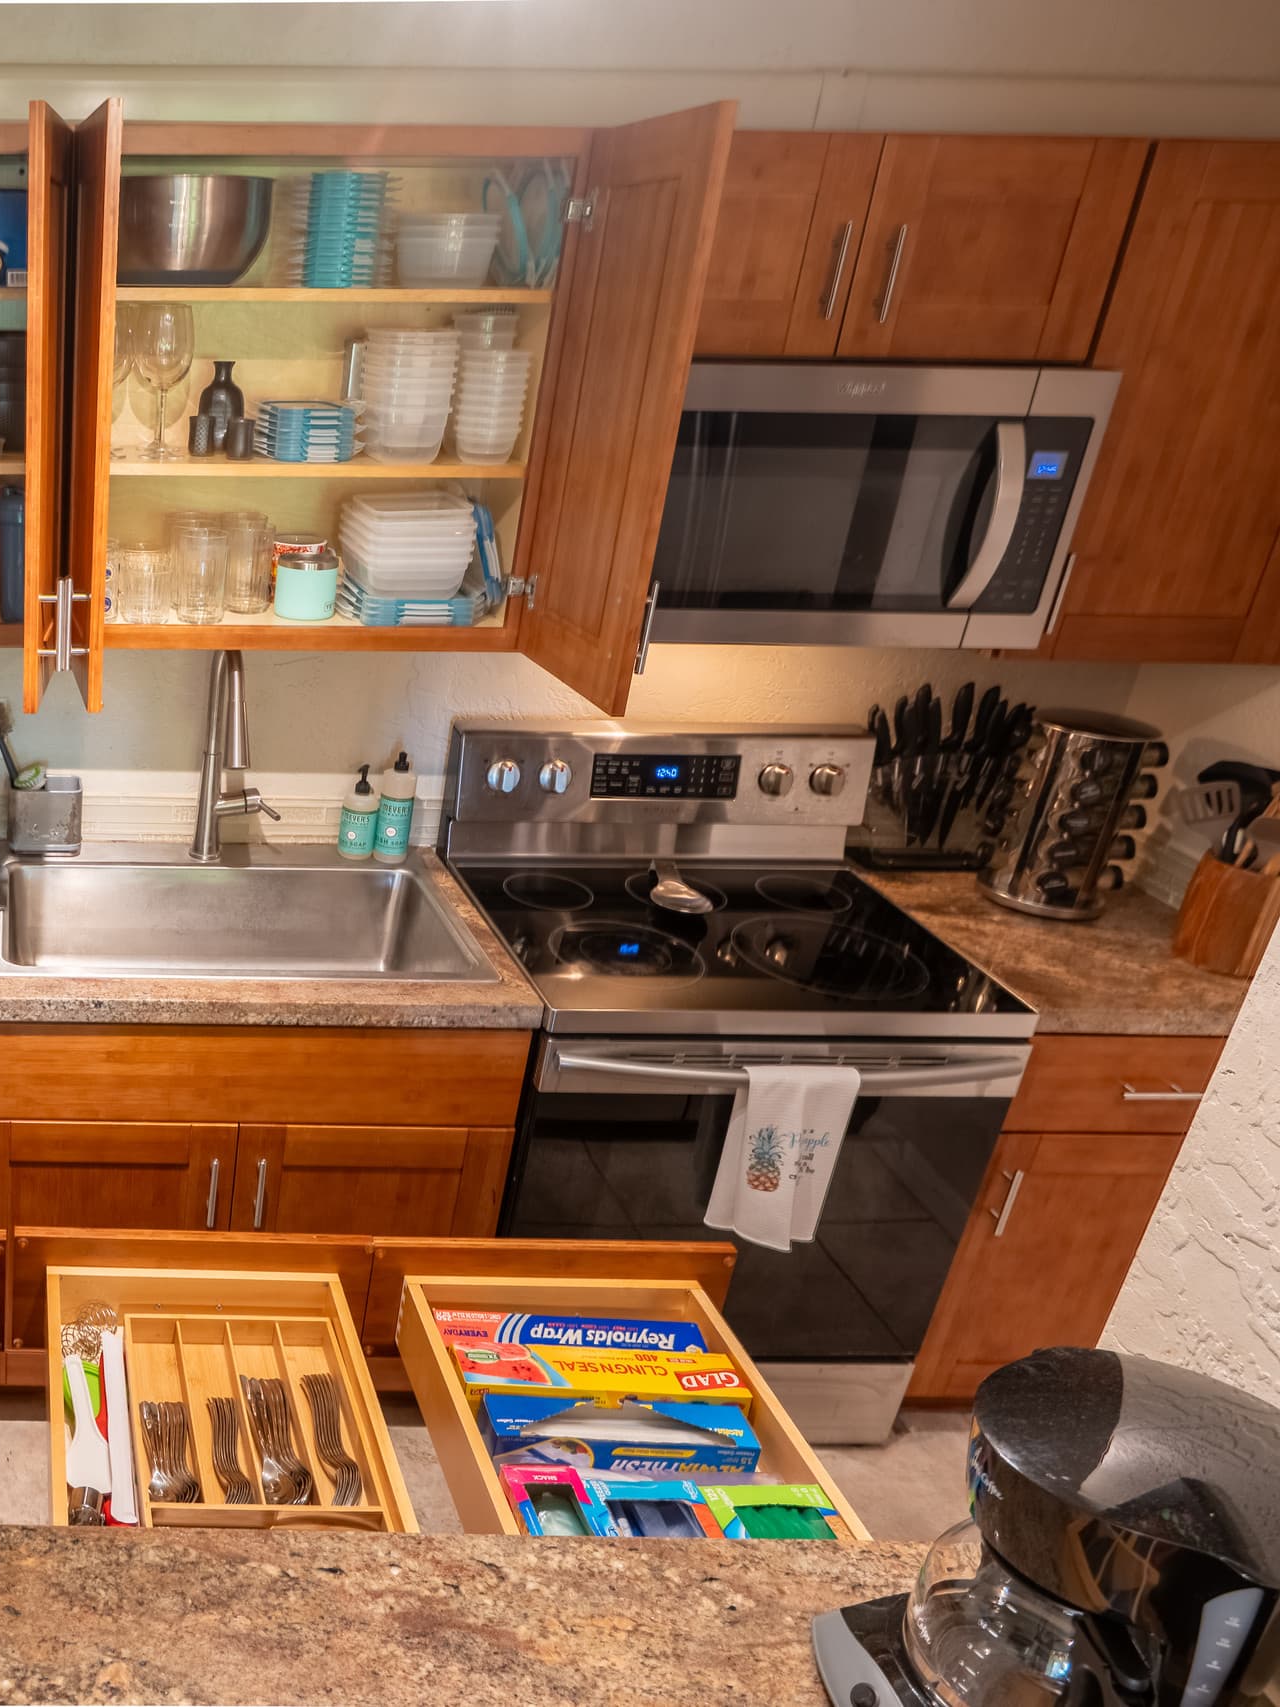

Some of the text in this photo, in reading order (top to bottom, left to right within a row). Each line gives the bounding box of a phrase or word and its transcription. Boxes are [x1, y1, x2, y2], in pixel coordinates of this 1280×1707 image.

[656, 767, 678, 778] 12:40
[530, 1323, 675, 1350] Reynolds Wrap
[635, 1353, 658, 1362] 400
[552, 1360, 596, 1374] SEAL
[682, 1372, 740, 1388] GLAD
